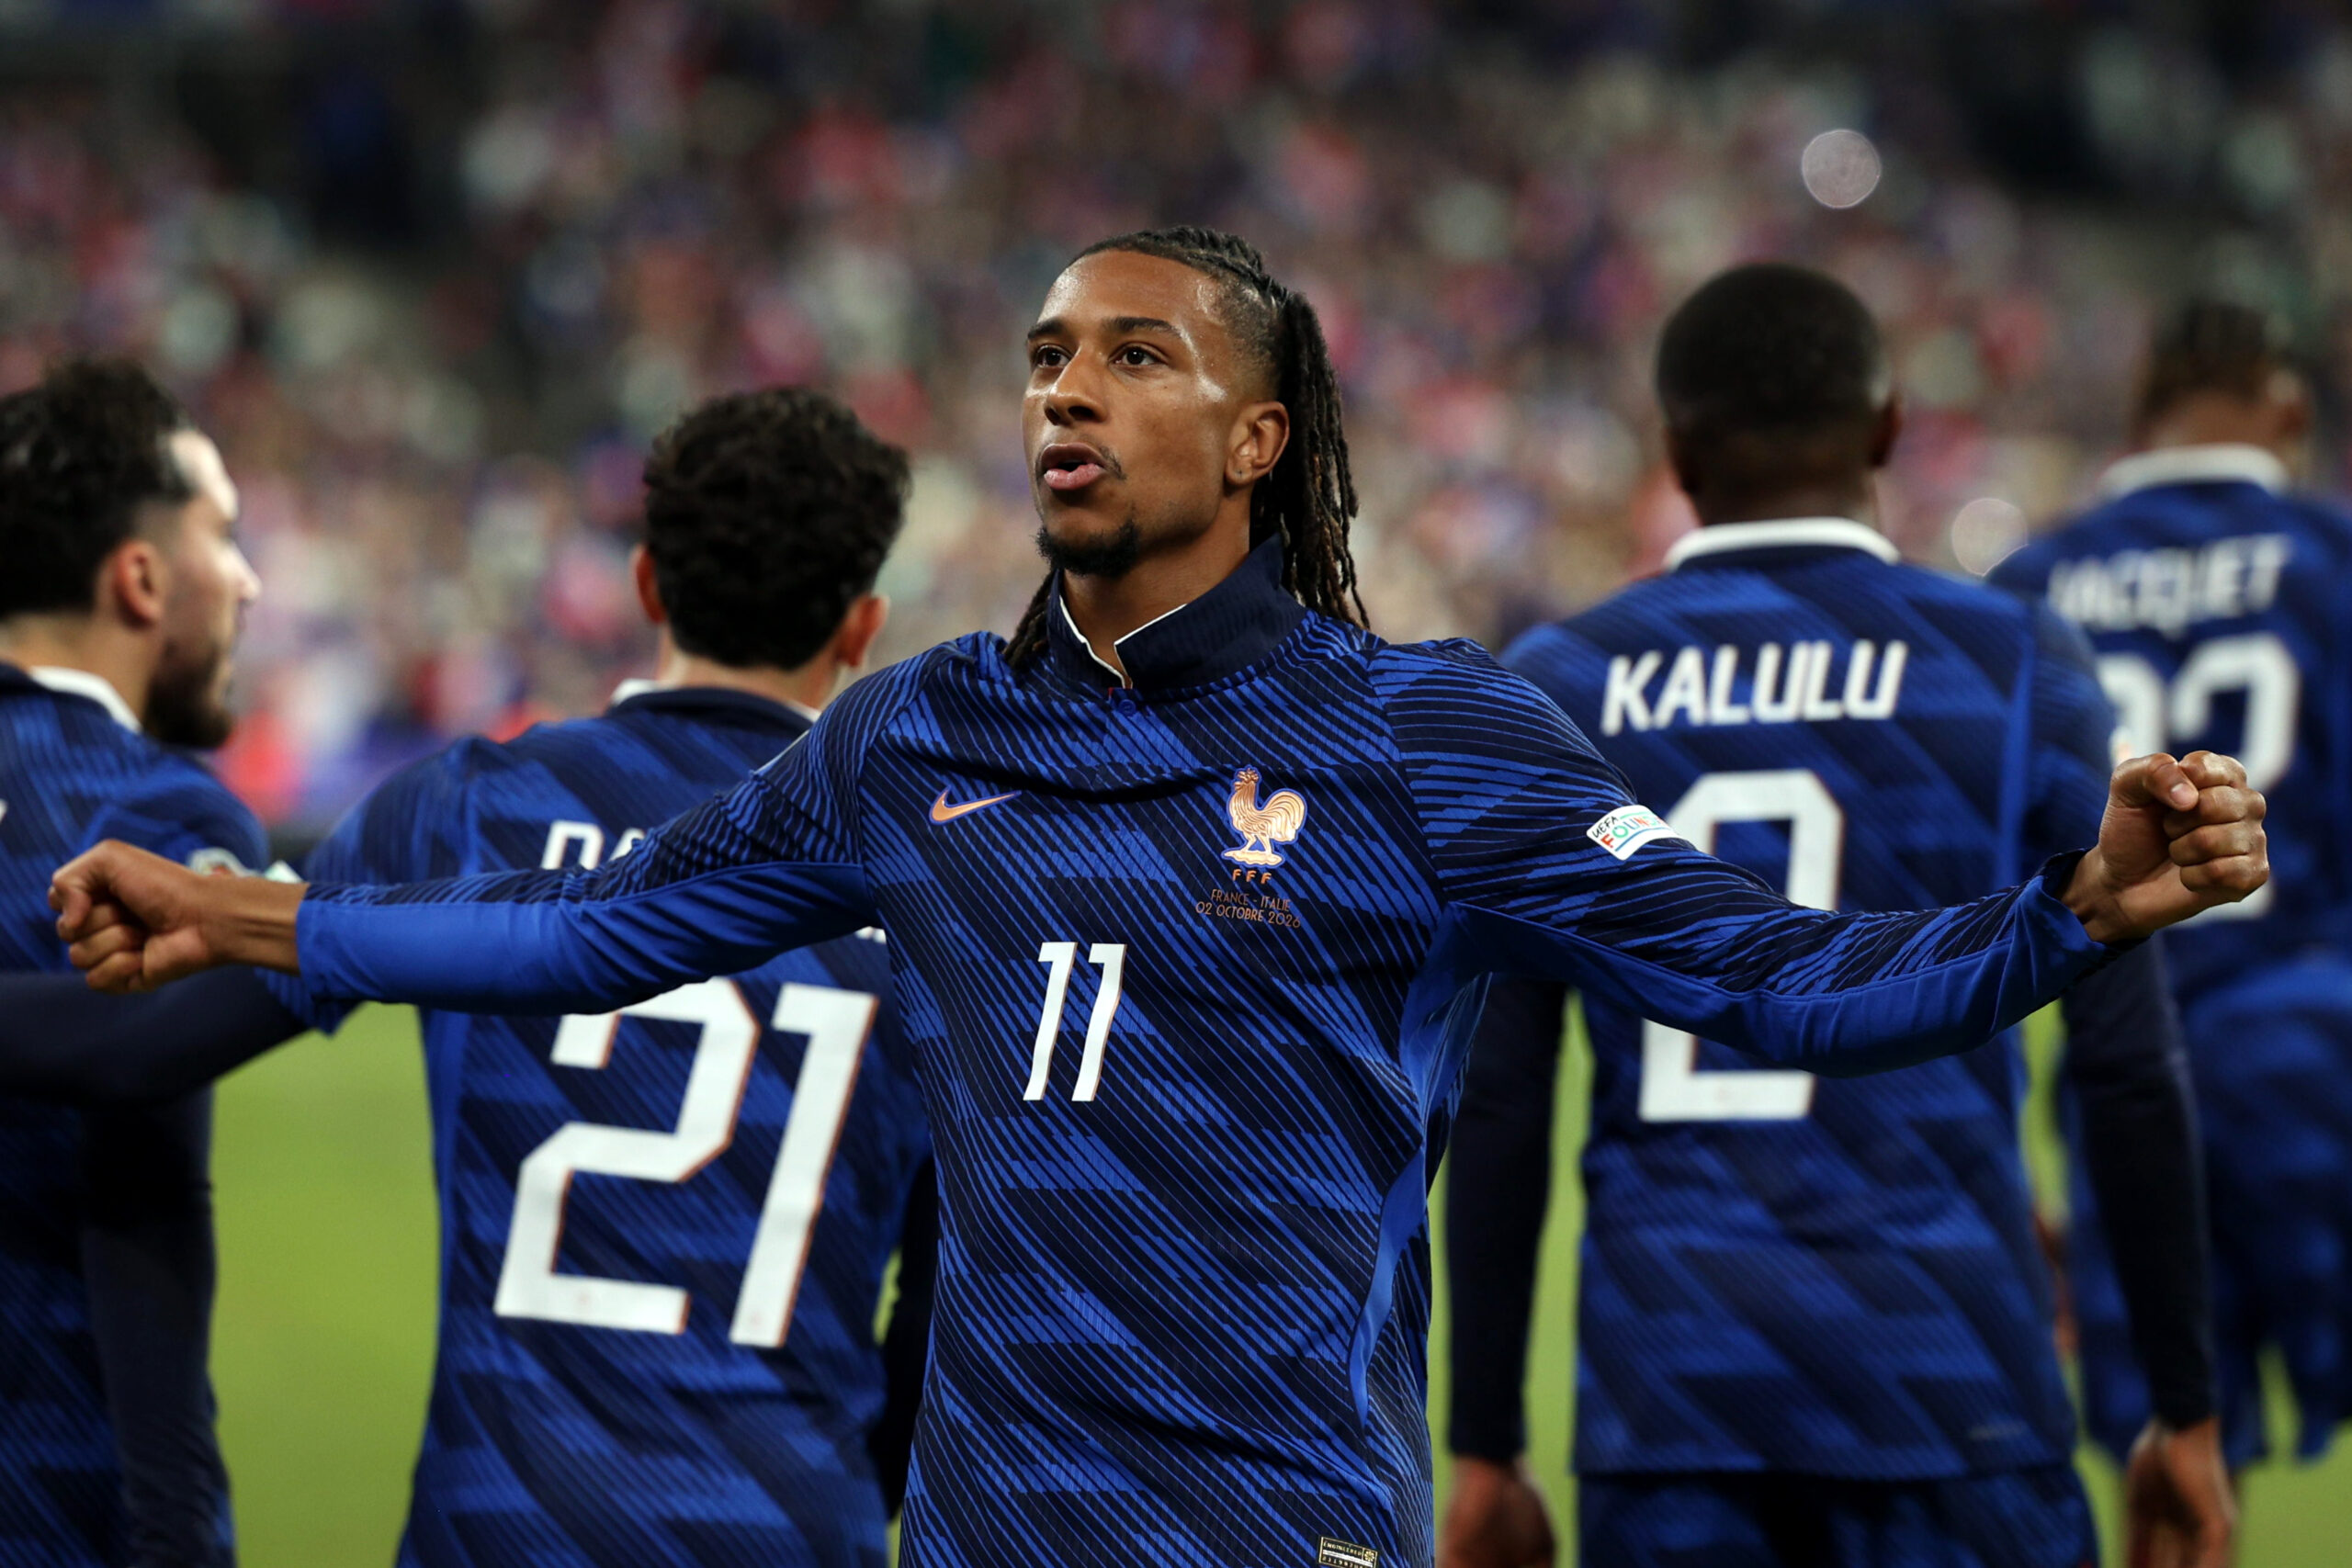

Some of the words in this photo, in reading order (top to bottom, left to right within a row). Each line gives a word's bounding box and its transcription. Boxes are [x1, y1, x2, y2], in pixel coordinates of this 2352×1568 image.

[1600, 639, 1908, 736] KALULU
[1591, 815, 1619, 838] UEFA
[1195, 901, 1213, 915] 02
[1216, 904, 1264, 922] OCTOBRE
[1268, 911, 1301, 929] 2026
[1210, 888, 1250, 906] FRANCE
[1260, 896, 1291, 912] ITALIE
[1637, 768, 1844, 1122] 2
[1023, 942, 1127, 1102] 11
[493, 976, 879, 1348] 21
